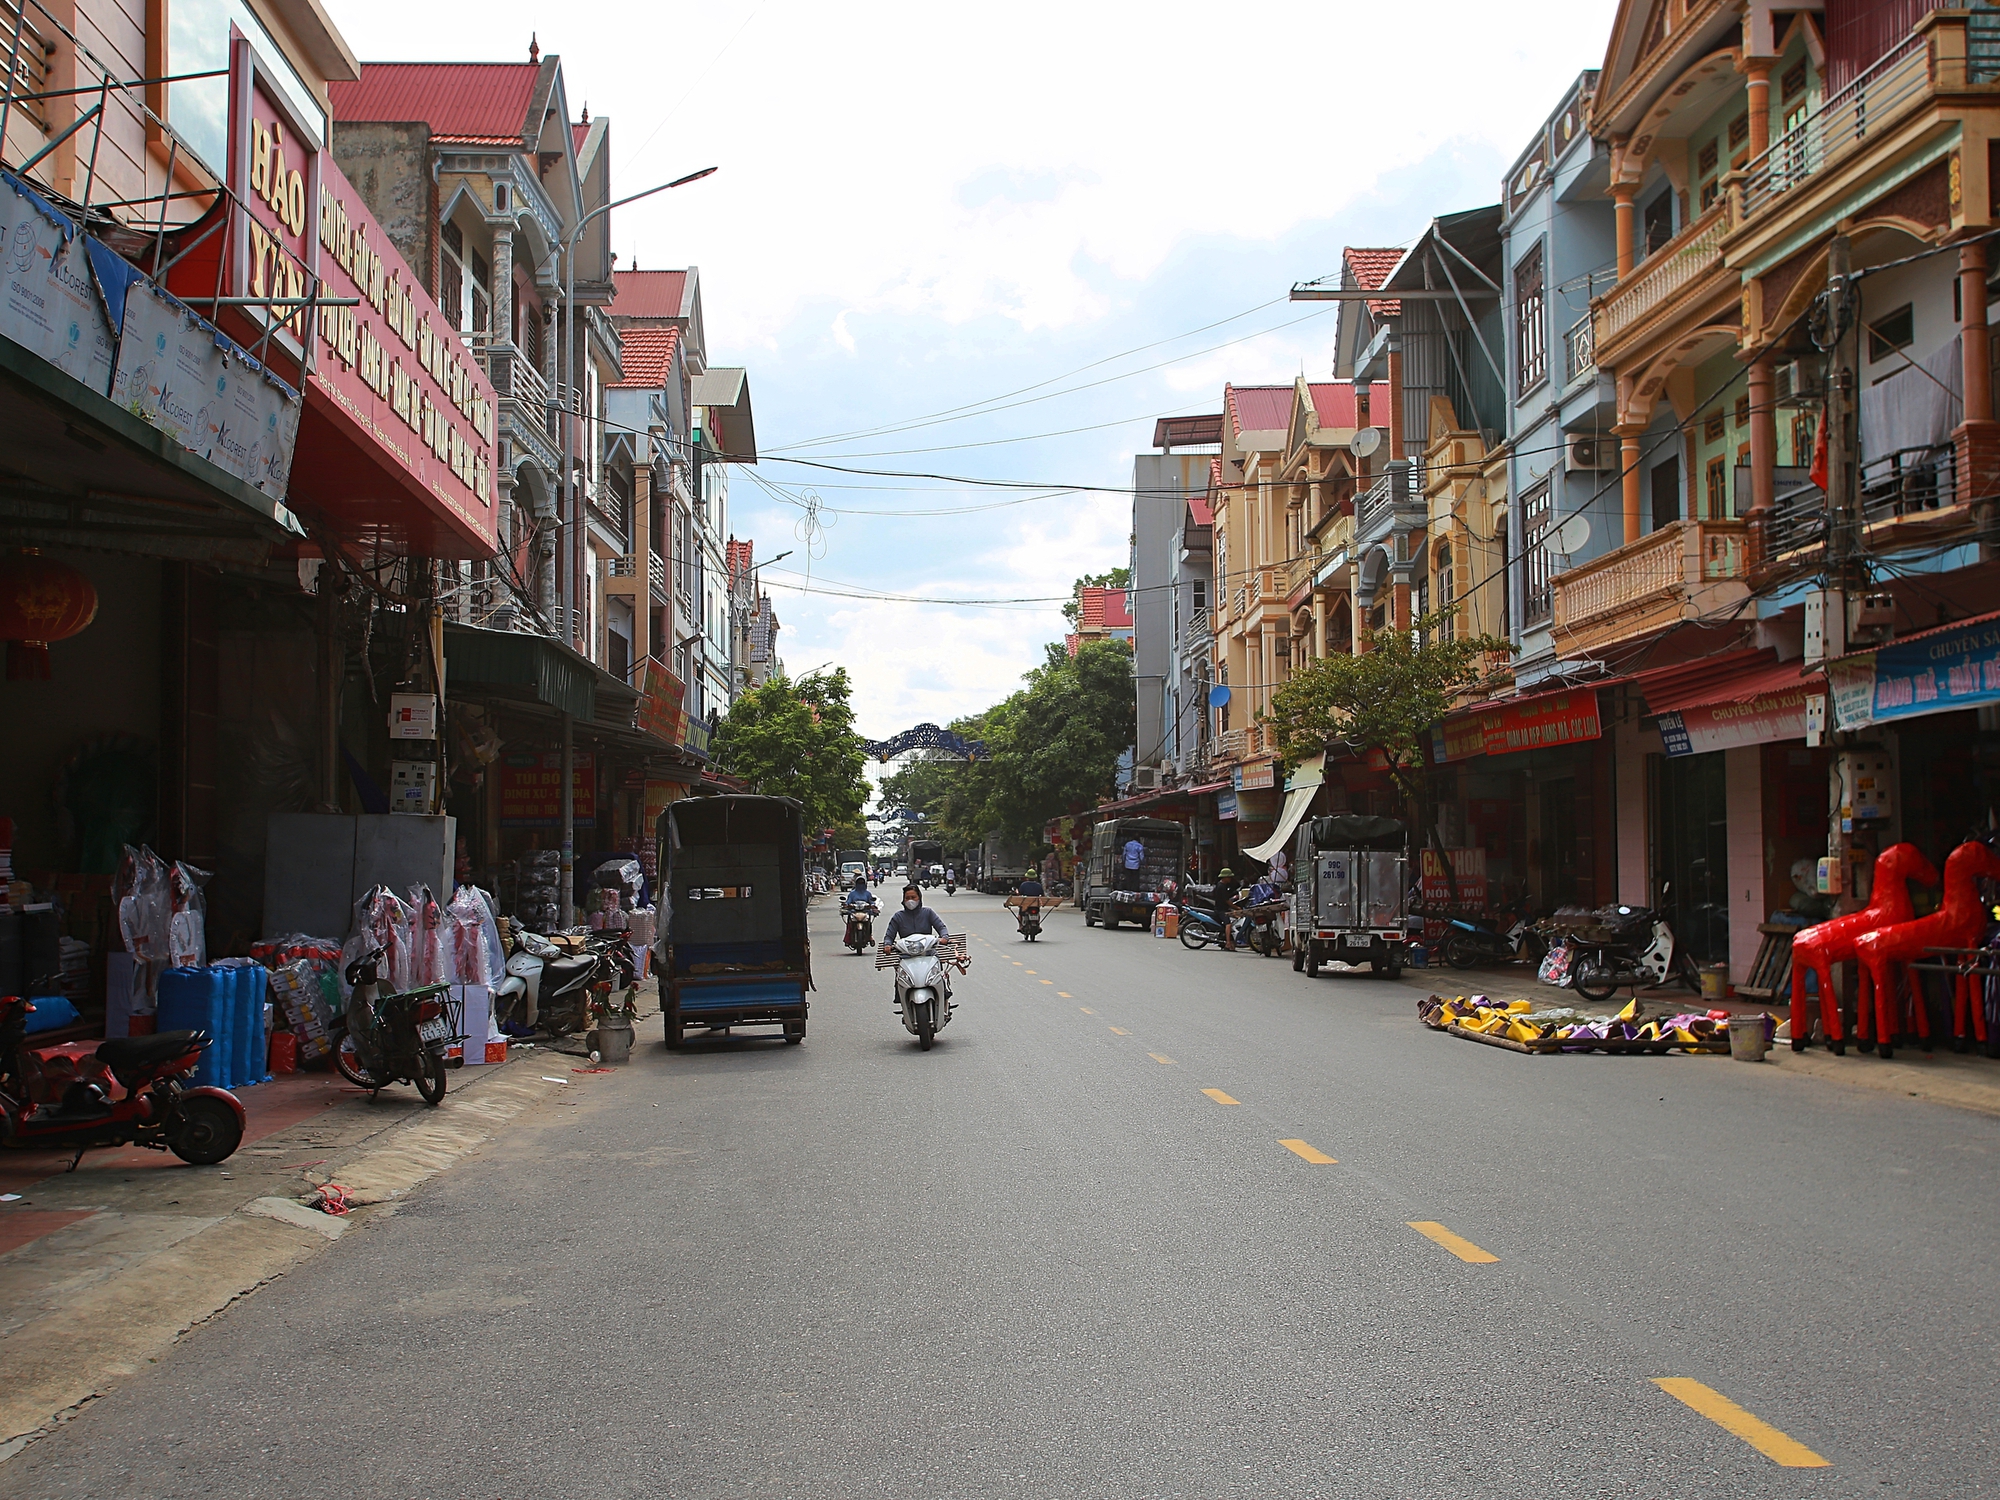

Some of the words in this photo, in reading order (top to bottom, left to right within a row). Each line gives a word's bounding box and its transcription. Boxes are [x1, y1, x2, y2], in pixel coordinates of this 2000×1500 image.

[252, 117, 305, 237] HÀO
[158, 381, 193, 427] ALCOREST
[216, 420, 247, 460] ALCOREST
[1929, 636, 1979, 660] CHUYÊN
[1877, 675, 1913, 709] HÀNG
[1948, 654, 1981, 696] GIẤY
[1711, 702, 1754, 721] CHUYÊN
[1755, 694, 1779, 713] SẢN
[515, 771, 537, 785] TÚI
[541, 771, 581, 785] BÓG
[504, 788, 531, 799] ĐINH
[533, 788, 548, 799] XU
[1323, 871, 1345, 879] 261.90
[1328, 861, 1341, 869] 99C
[1455, 850, 1485, 876] HOA
[1426, 886, 1451, 899] NÓN
[1463, 885, 1483, 898] MŨ
